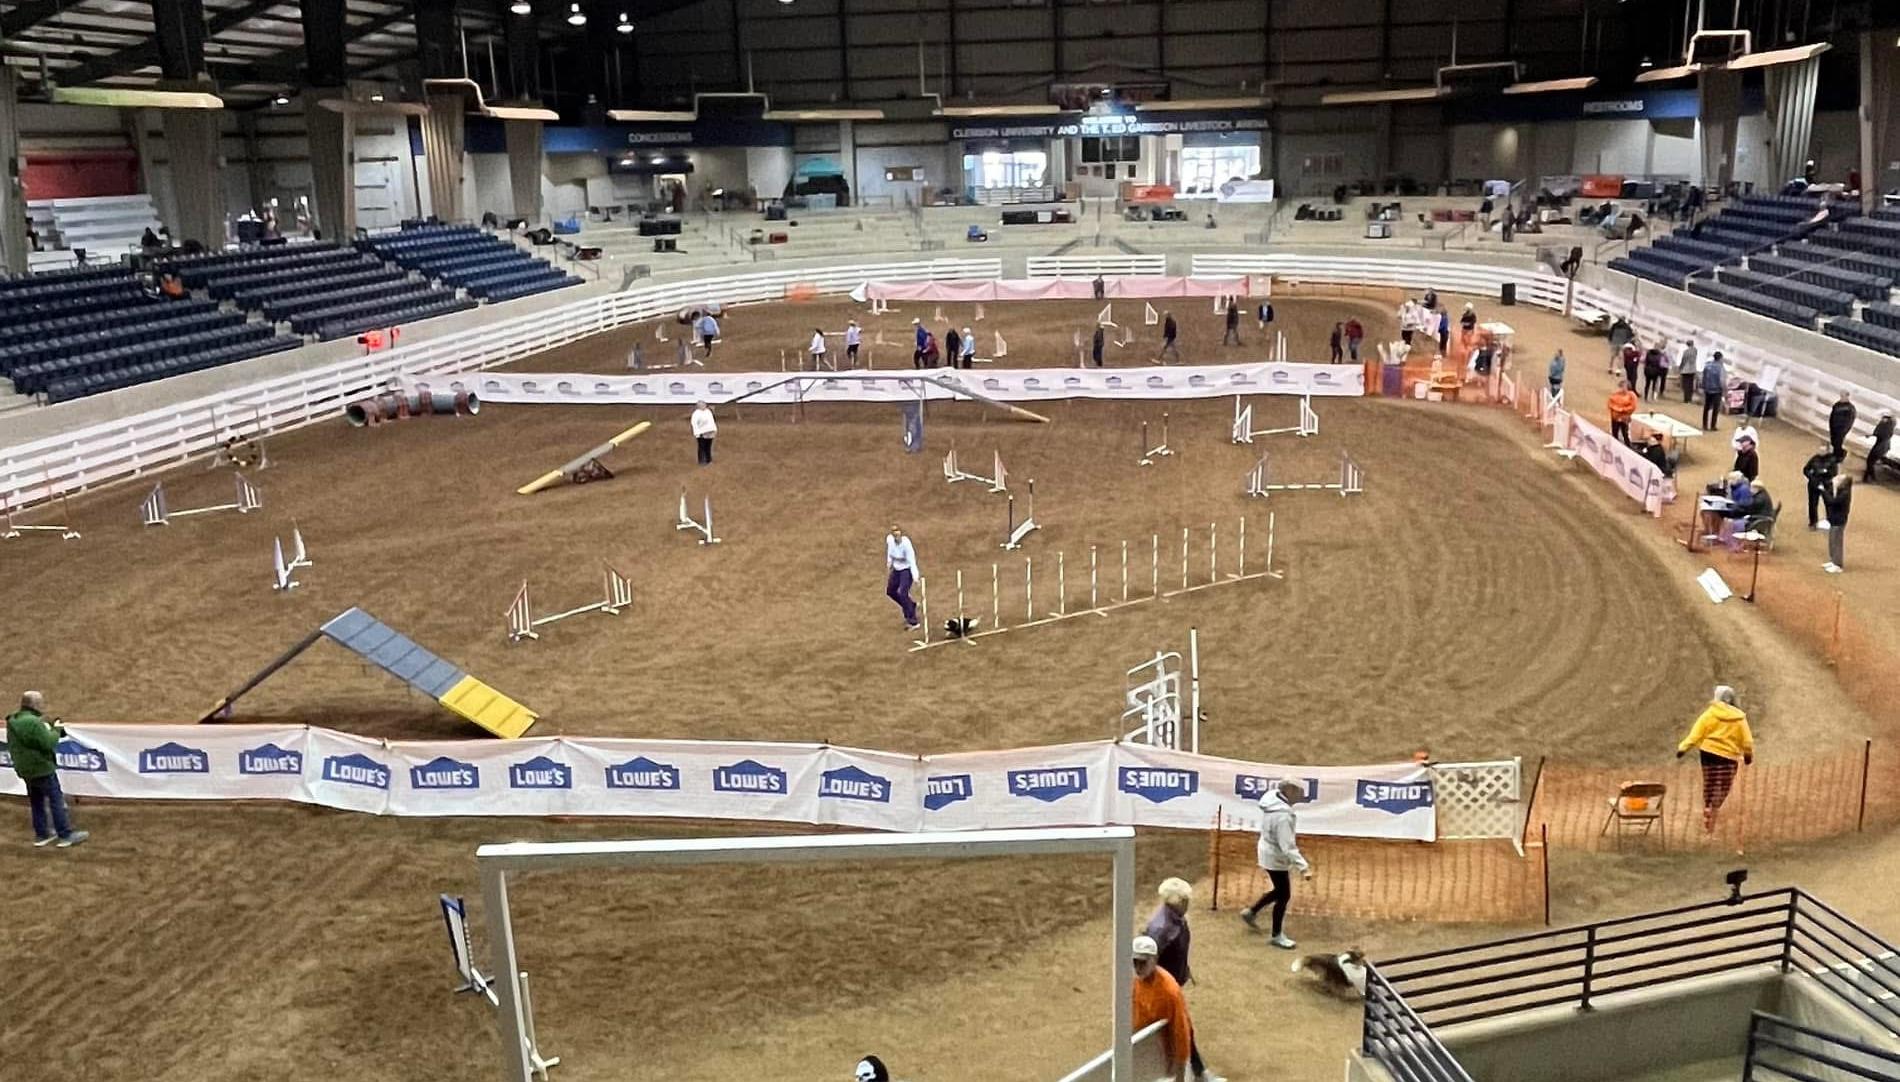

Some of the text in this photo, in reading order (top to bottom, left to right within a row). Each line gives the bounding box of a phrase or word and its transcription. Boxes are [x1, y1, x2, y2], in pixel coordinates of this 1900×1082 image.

[1000, 126, 1055, 137] UNIVERSITY
[1057, 125, 1078, 135] AND
[1080, 124, 1099, 135] THE
[1180, 120, 1232, 131] LIVESTOCK
[1235, 119, 1269, 129] ARENA
[56, 752, 101, 770] OWE'S
[146, 754, 202, 770] LOWE'S
[245, 754, 299, 771] LOWE'S
[330, 761, 387, 786] LOWE'S
[417, 768, 473, 786] LOWE'S
[516, 768, 564, 785] LOWE'S
[612, 769, 673, 787] LOWE'S
[720, 770, 781, 791] LOWE'S
[1015, 771, 1080, 791] LOWE'S
[1126, 770, 1191, 791] LOWE'S
[820, 775, 883, 799] LOWE'S
[928, 779, 965, 795] LOW
[1362, 784, 1432, 803] LOWE'S
